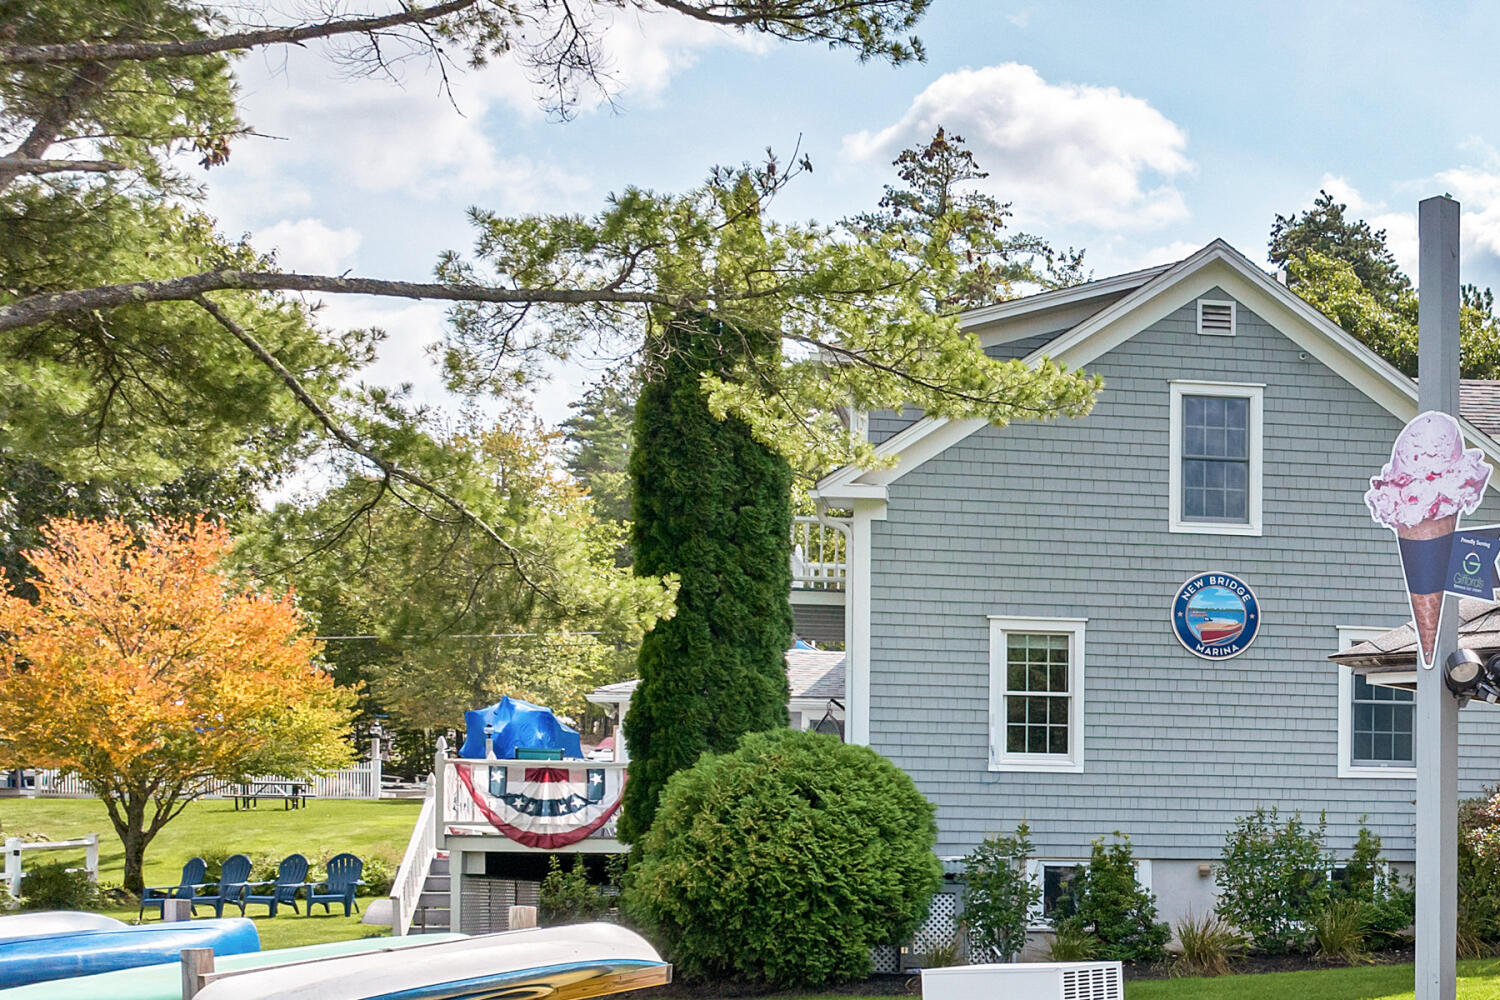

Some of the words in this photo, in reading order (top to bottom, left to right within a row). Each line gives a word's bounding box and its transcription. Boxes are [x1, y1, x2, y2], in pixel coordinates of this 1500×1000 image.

[1181, 578, 1204, 601] NEW
[1209, 576, 1251, 602] BRIDGE
[1195, 644, 1240, 656] MARINA
